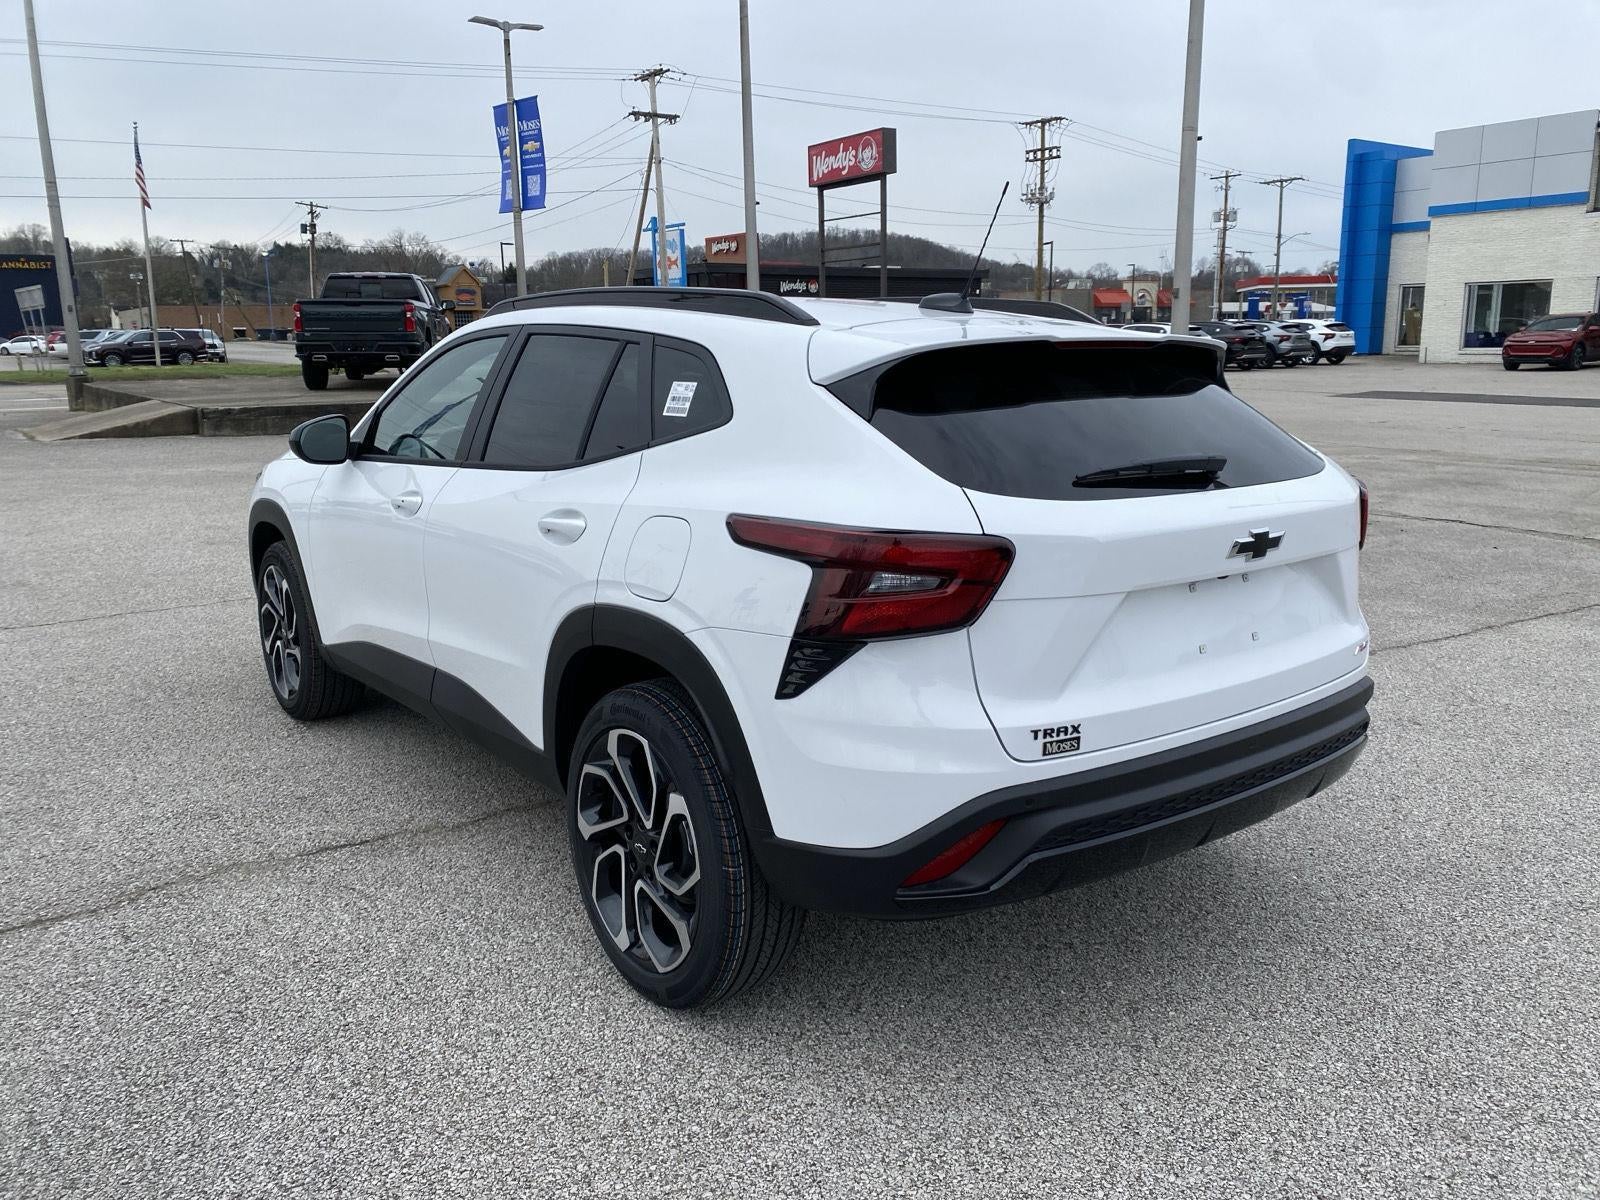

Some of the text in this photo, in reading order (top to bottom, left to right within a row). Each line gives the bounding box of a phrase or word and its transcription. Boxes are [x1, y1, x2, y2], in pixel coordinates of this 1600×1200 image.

[518, 119, 541, 132] MOSES
[812, 142, 856, 182] Wendy's
[711, 238, 731, 255] Wendy's
[0, 261, 52, 269] ANNABIST
[780, 279, 807, 293] Wendy's
[1030, 723, 1082, 741] TRAX
[1045, 739, 1078, 755] MOSES
